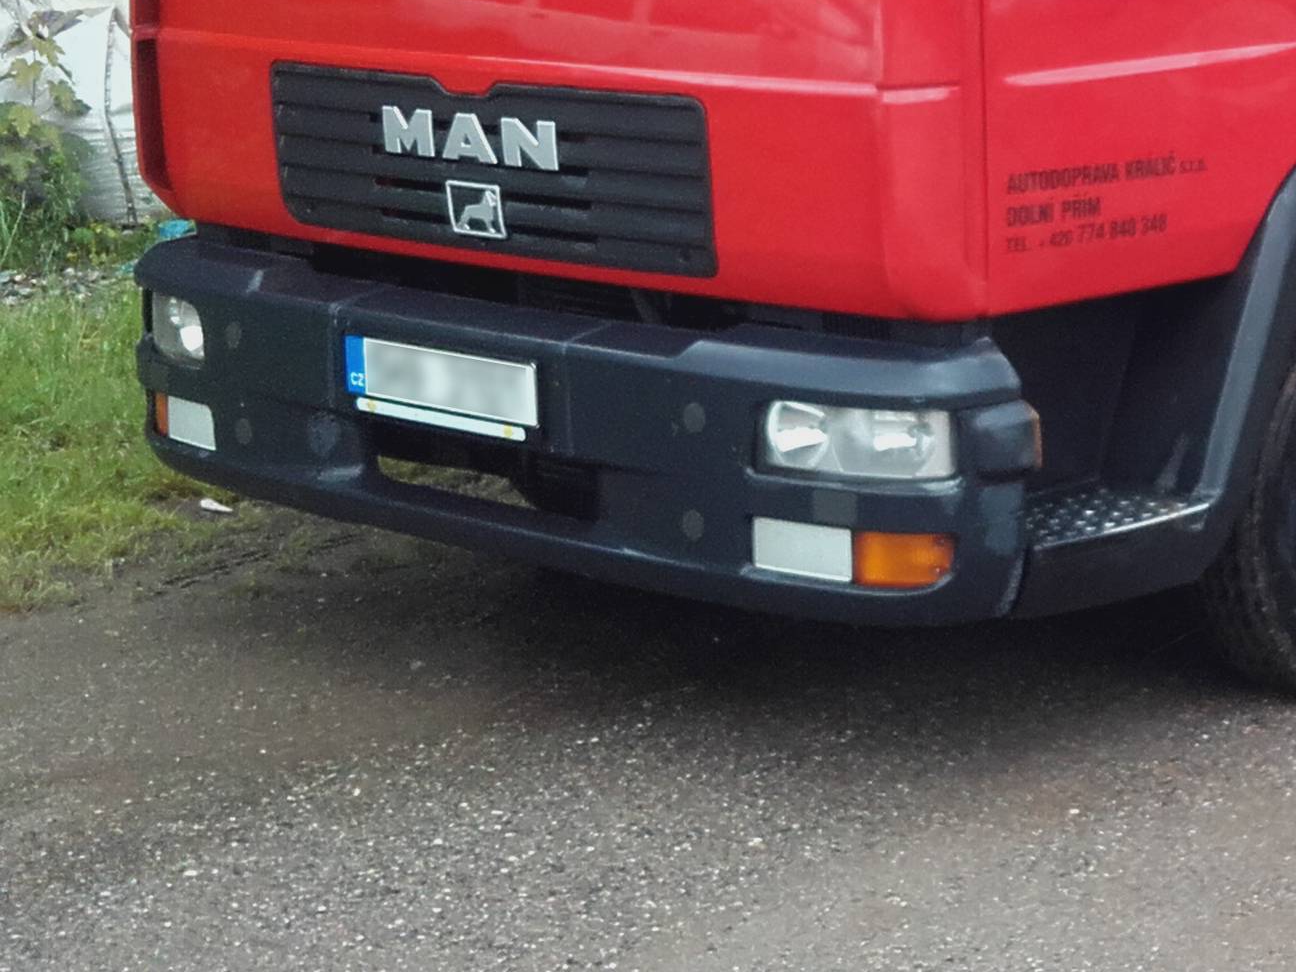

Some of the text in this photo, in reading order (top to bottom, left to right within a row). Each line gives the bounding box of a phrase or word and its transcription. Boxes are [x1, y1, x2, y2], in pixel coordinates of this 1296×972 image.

[381, 105, 560, 171] MAN
[1006, 162, 1120, 194] AUTODOPRAVA
[350, 371, 365, 387] CZ
